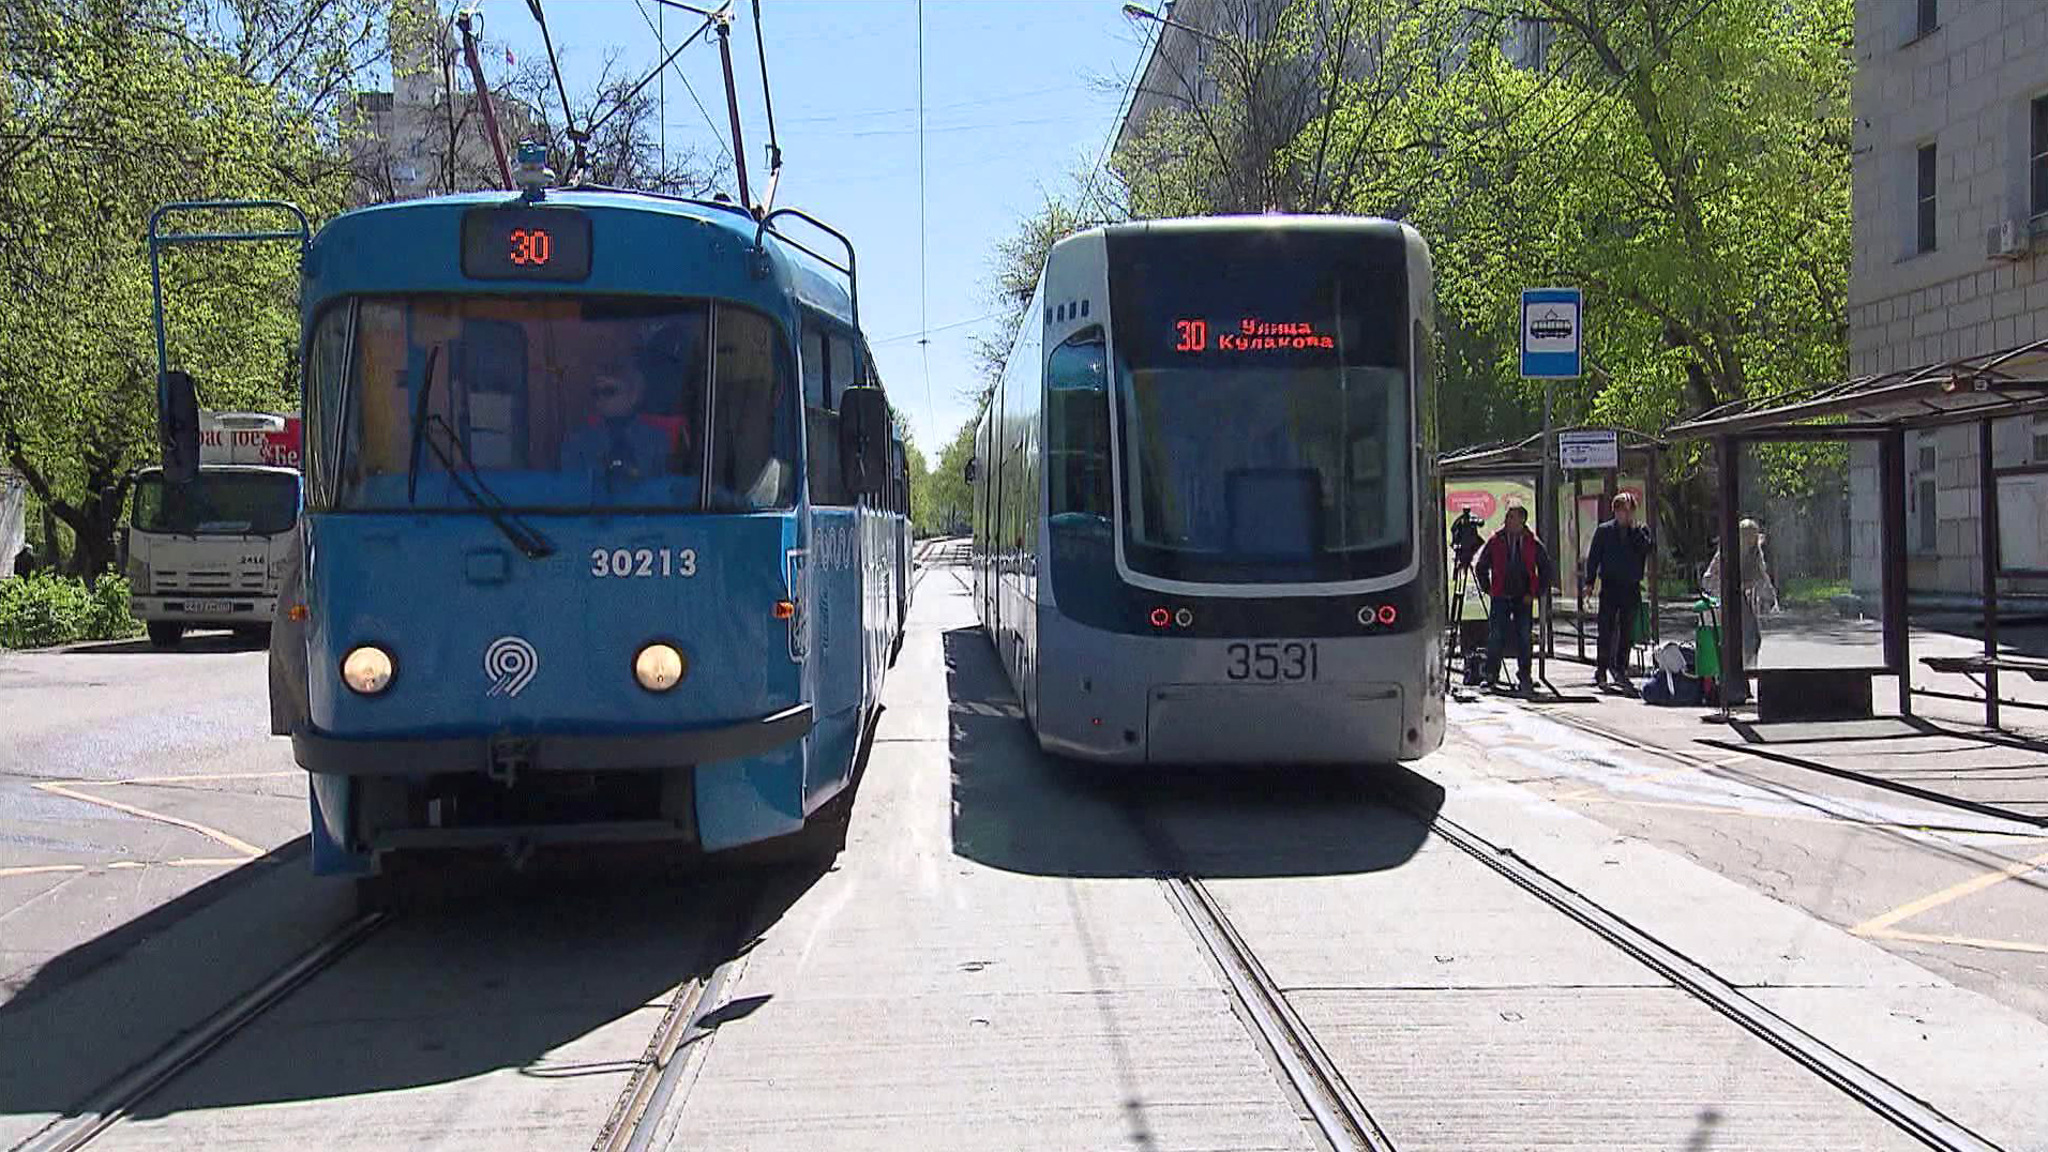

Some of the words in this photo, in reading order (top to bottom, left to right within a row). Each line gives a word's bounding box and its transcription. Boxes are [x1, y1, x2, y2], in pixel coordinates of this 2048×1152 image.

[511, 230, 549, 264] 30
[1176, 320, 1206, 351] 30
[1240, 318, 1312, 335] Улица
[1219, 333, 1335, 351] Кулакова
[591, 548, 697, 577] 30213
[1227, 641, 1318, 682] 3531
